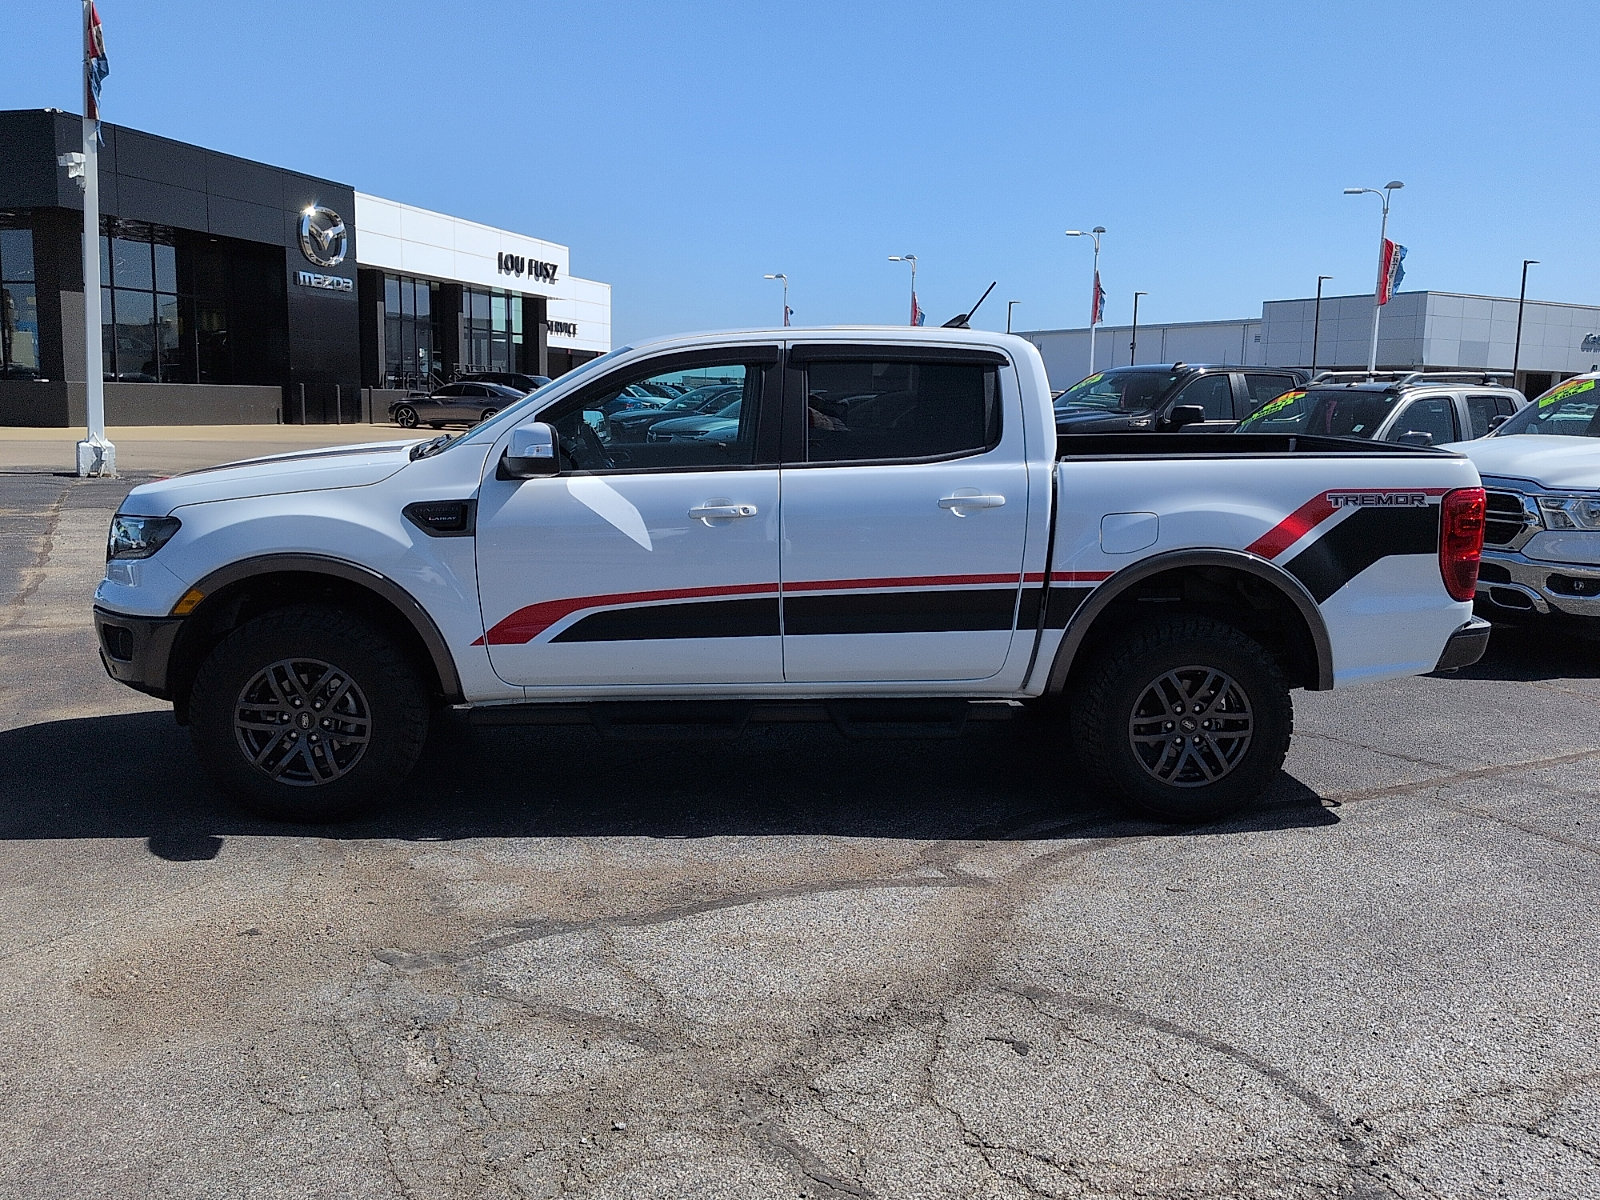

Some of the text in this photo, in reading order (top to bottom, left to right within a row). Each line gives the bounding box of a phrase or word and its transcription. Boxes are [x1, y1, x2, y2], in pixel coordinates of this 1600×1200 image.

[498, 252, 559, 282] LOU FUSZ
[1327, 493, 1428, 508] TREMOR
